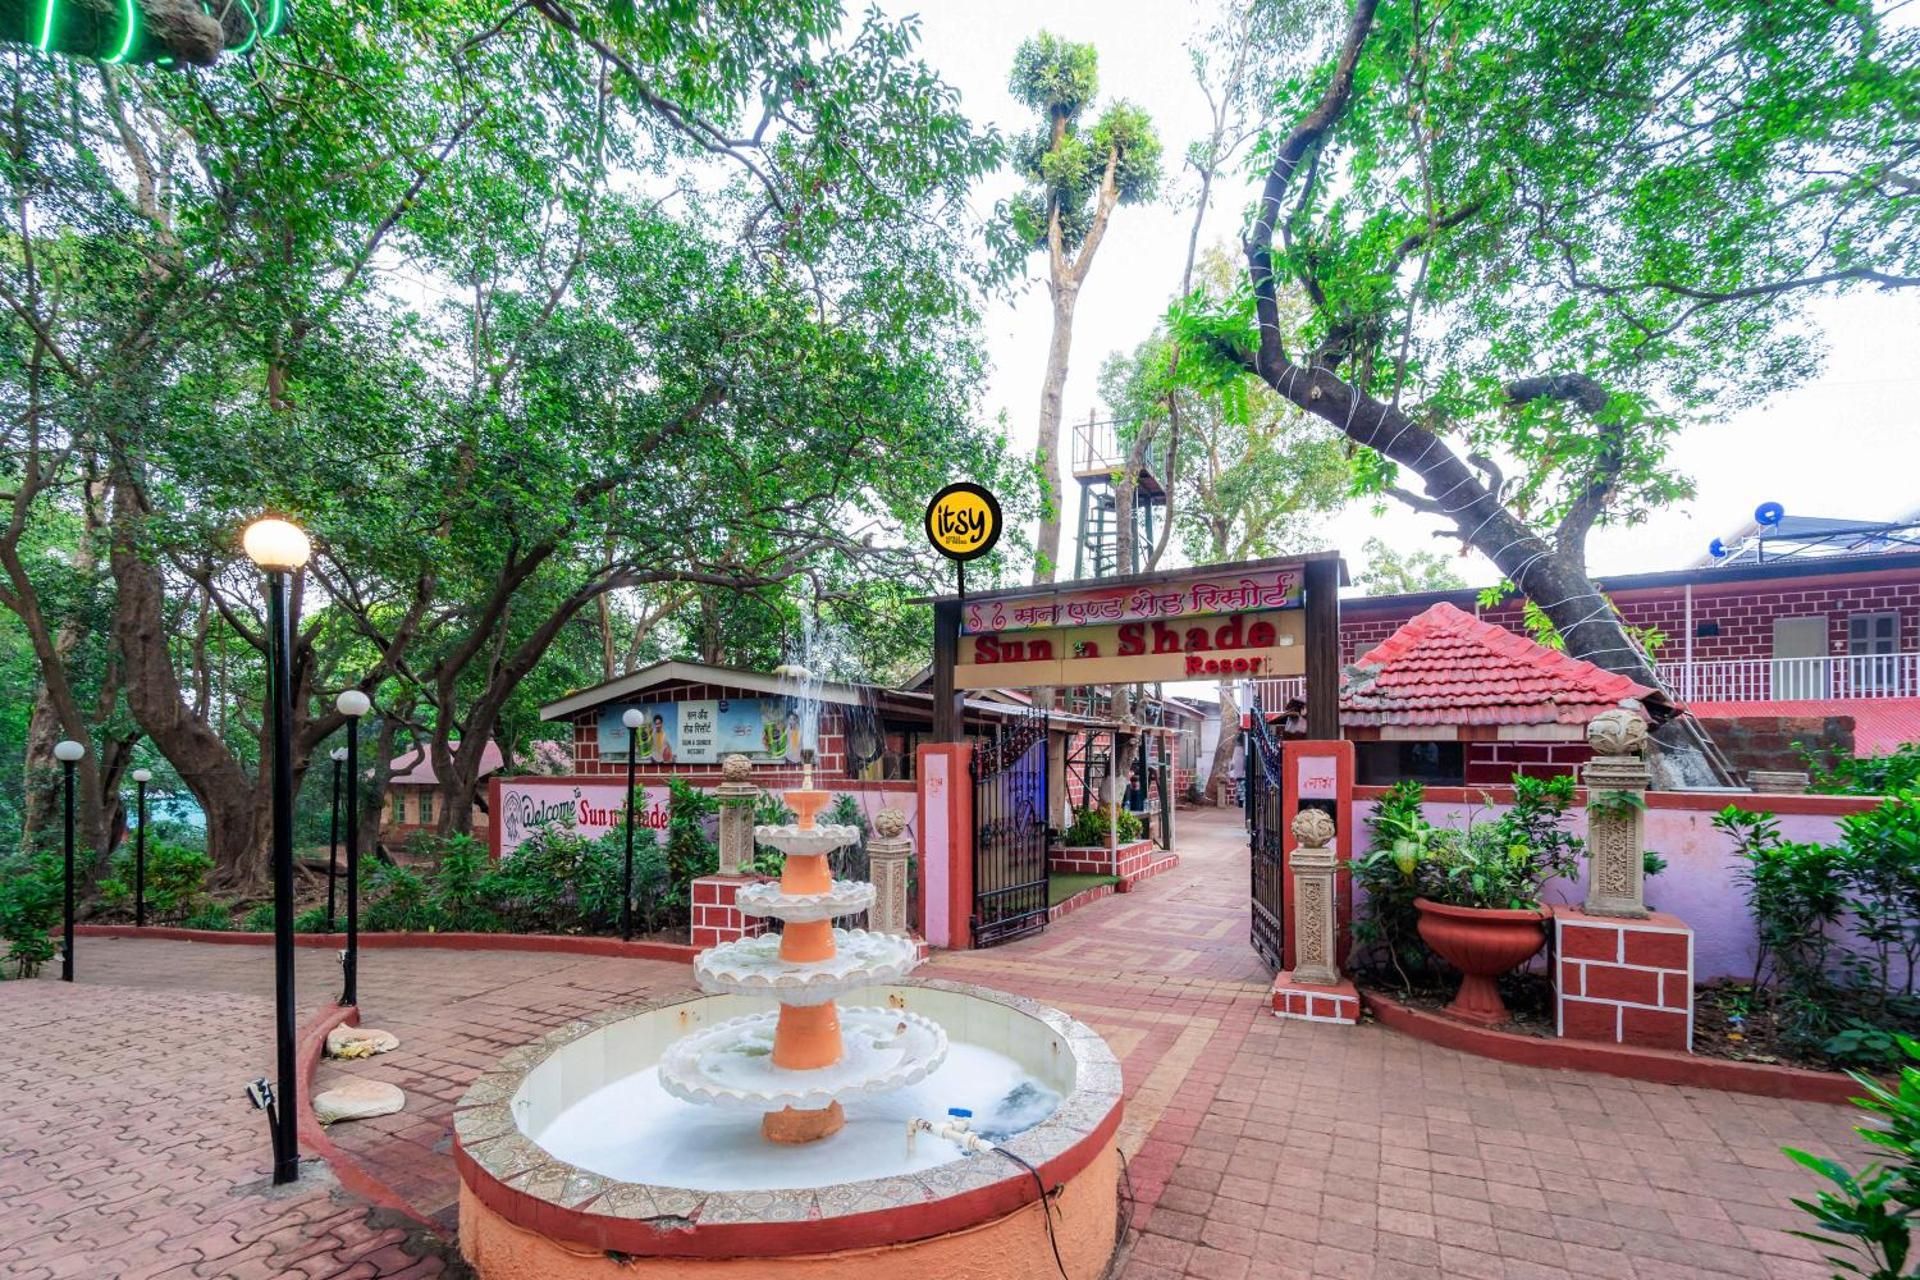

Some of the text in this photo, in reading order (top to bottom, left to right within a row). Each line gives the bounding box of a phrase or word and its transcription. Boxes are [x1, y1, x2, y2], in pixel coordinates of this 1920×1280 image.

[937, 504, 985, 543] itsy
[974, 634, 1056, 664] Sun
[1118, 615, 1277, 656] Shade
[522, 794, 576, 828] Welcome
[573, 786, 582, 799] to
[578, 799, 607, 826] Sun
